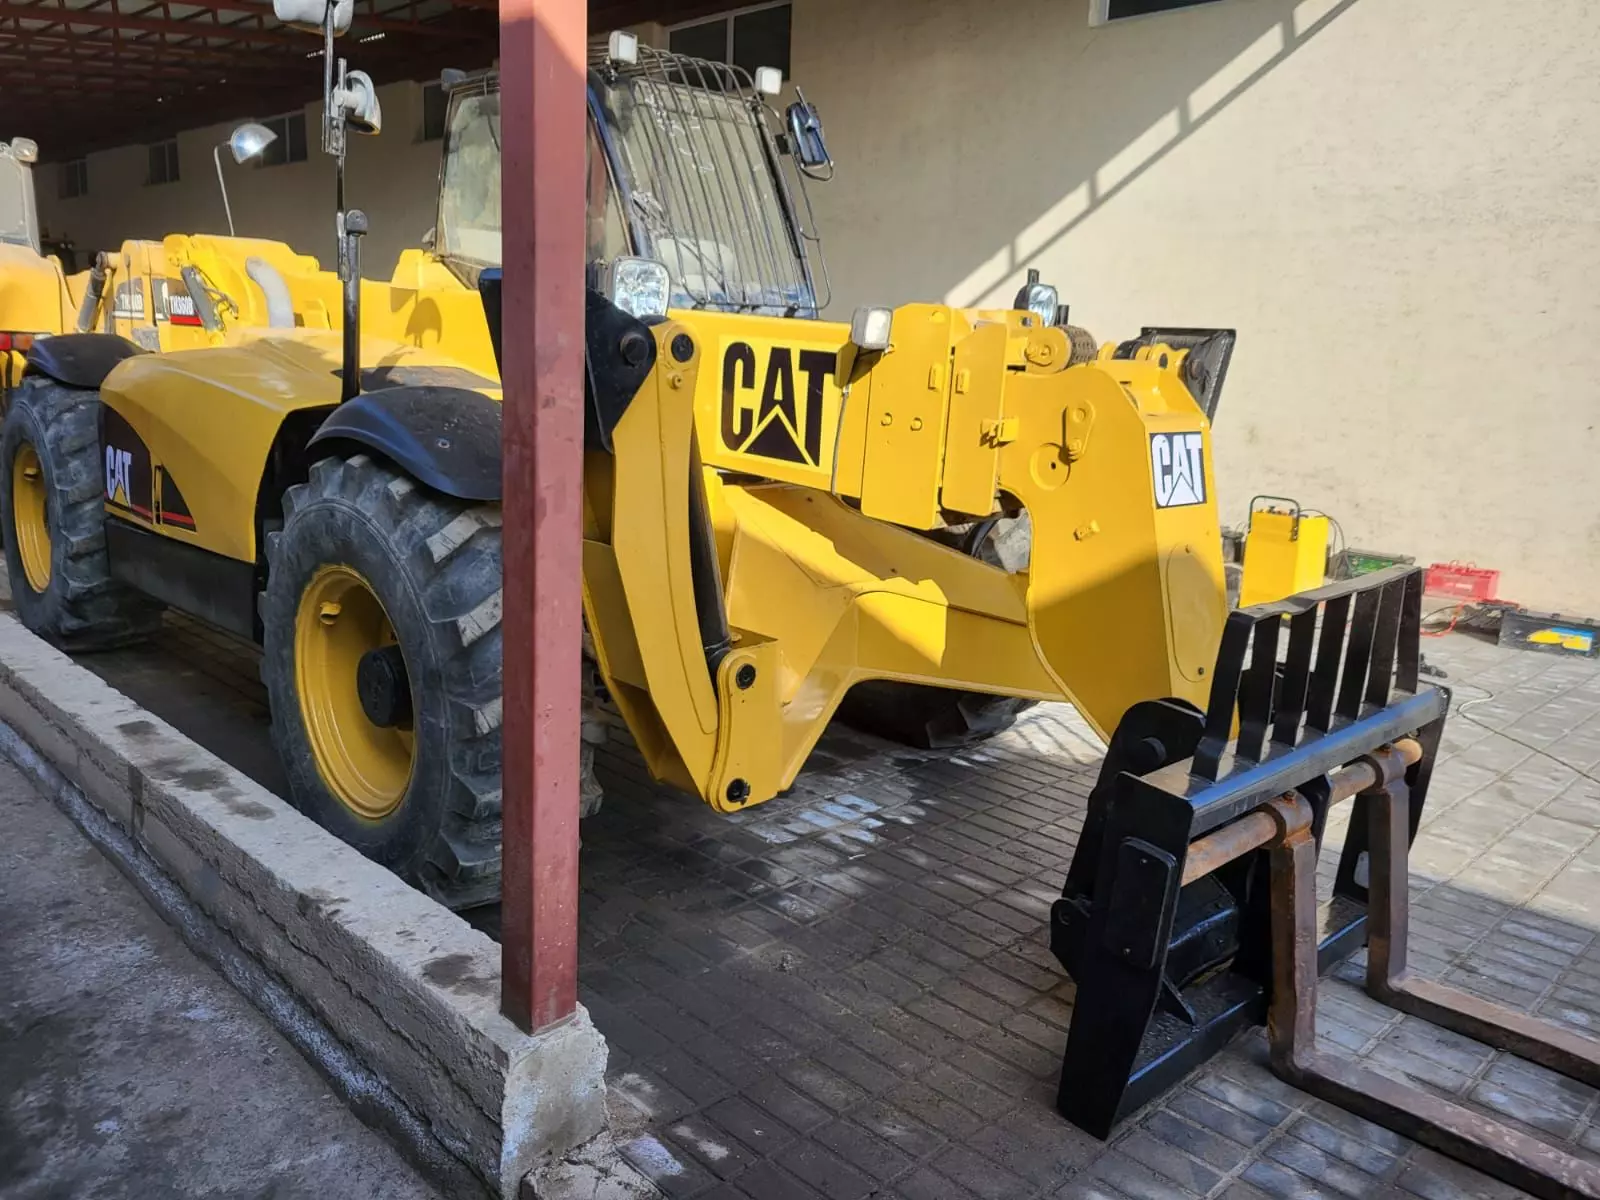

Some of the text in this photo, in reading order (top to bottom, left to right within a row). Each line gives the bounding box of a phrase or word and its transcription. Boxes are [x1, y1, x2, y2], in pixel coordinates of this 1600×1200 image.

[720, 341, 837, 467] CAT
[105, 444, 132, 509] CAT
[1152, 434, 1204, 507] CAT
